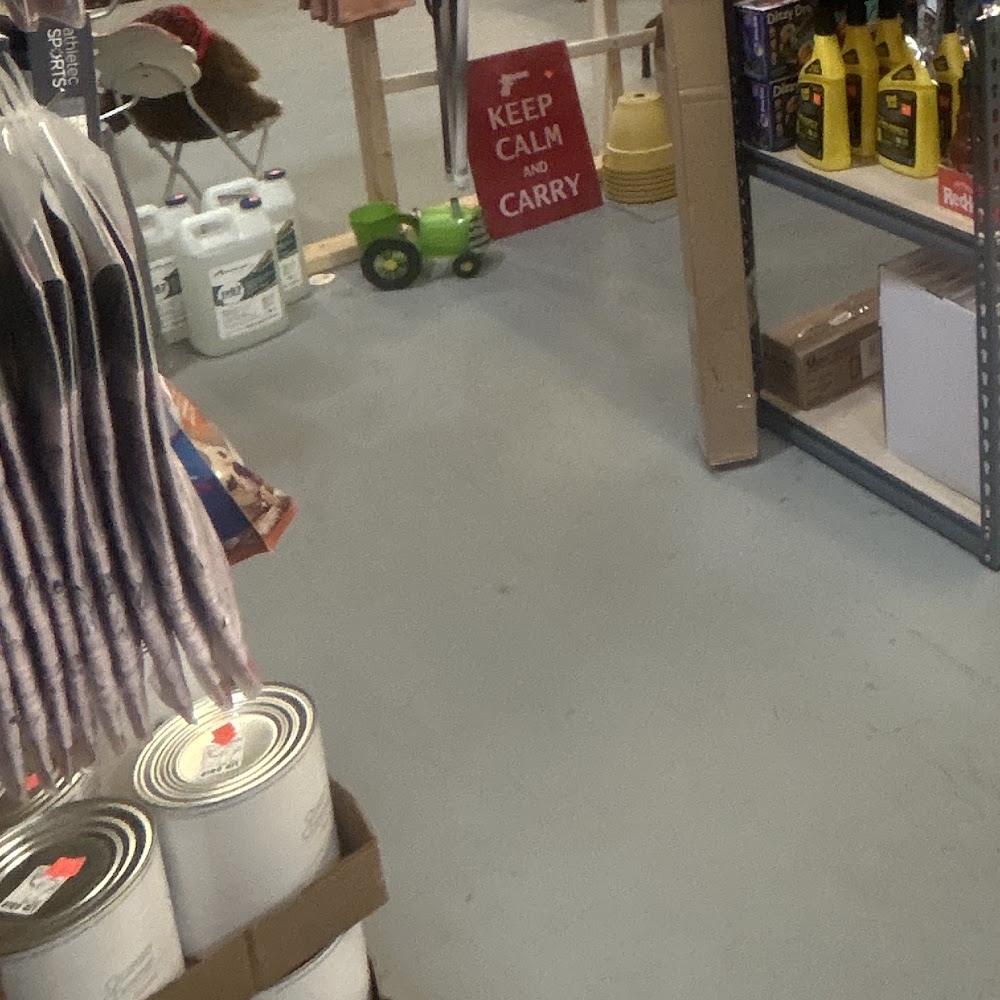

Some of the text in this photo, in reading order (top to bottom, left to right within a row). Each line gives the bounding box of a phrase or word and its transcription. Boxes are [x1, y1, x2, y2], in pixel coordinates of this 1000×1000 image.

[62, 27, 80, 86] athletec
[487, 93, 553, 131] KEEP
[495, 123, 564, 162] CALM
[523, 161, 549, 178] AND
[499, 173, 581, 218] CARRY
